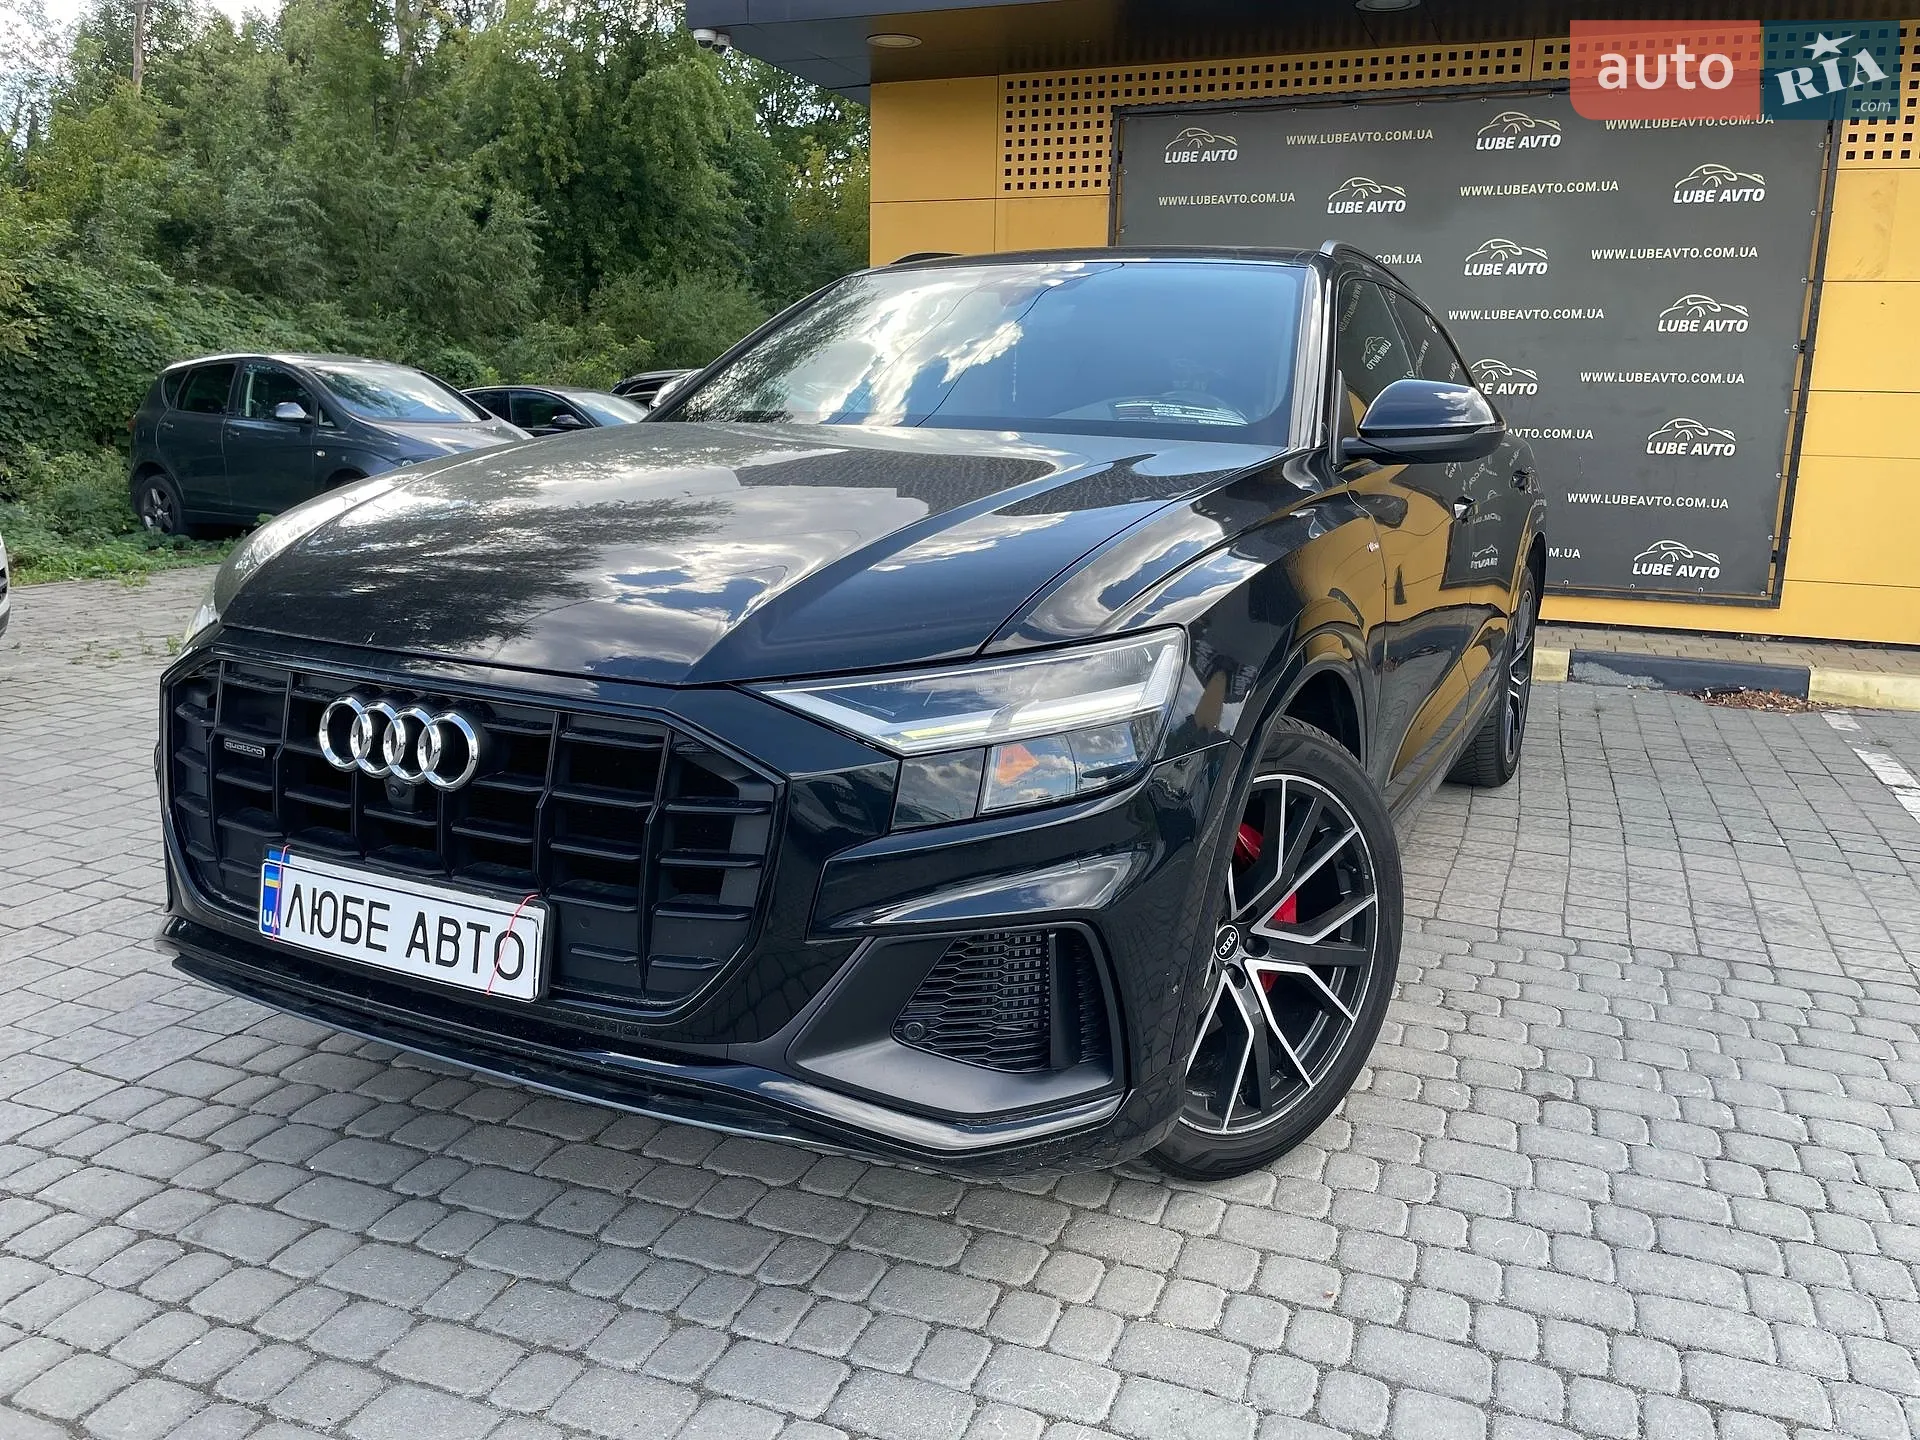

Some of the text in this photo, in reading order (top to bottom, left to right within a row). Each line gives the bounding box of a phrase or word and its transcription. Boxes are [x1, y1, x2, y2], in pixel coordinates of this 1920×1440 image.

[1605, 113, 1775, 131] WWW.LUBEAVTO.COM.UA
[1286, 129, 1434, 146] WWW.LUBEAVTO.COM.UA
[1475, 134, 1562, 151] LUBE AVTO
[1164, 148, 1238, 164] LUBE AVTO
[1460, 180, 1619, 197] WWW.LUBEAVTO.COM.UA
[1673, 187, 1766, 204] LUBE AVTO
[1158, 192, 1296, 206] WWW.LUBEAVTO.COM.UA
[1326, 199, 1407, 214] LUBE AVTO
[1591, 246, 1758, 260] WWW.LUBEAVTO.COM.UA
[1463, 262, 1549, 276] LUBE AVTO
[1448, 308, 1605, 321] WWW.LUBEAVTO.COM.UA
[1657, 319, 1749, 333] LUBE AVTO
[1580, 371, 1745, 385] WWW.LUBEAVTO.COM.UA
[1495, 382, 1538, 395] AVTO
[1646, 441, 1737, 457] LUBE AVTO
[1567, 492, 1729, 509] WWW.LUBEAVTO.COM.UA
[1632, 563, 1721, 579] LUBE AVTO
[225, 741, 263, 756] quattro
[263, 908, 280, 929] UA
[285, 882, 525, 981] ЛЮБЕ АВТО
